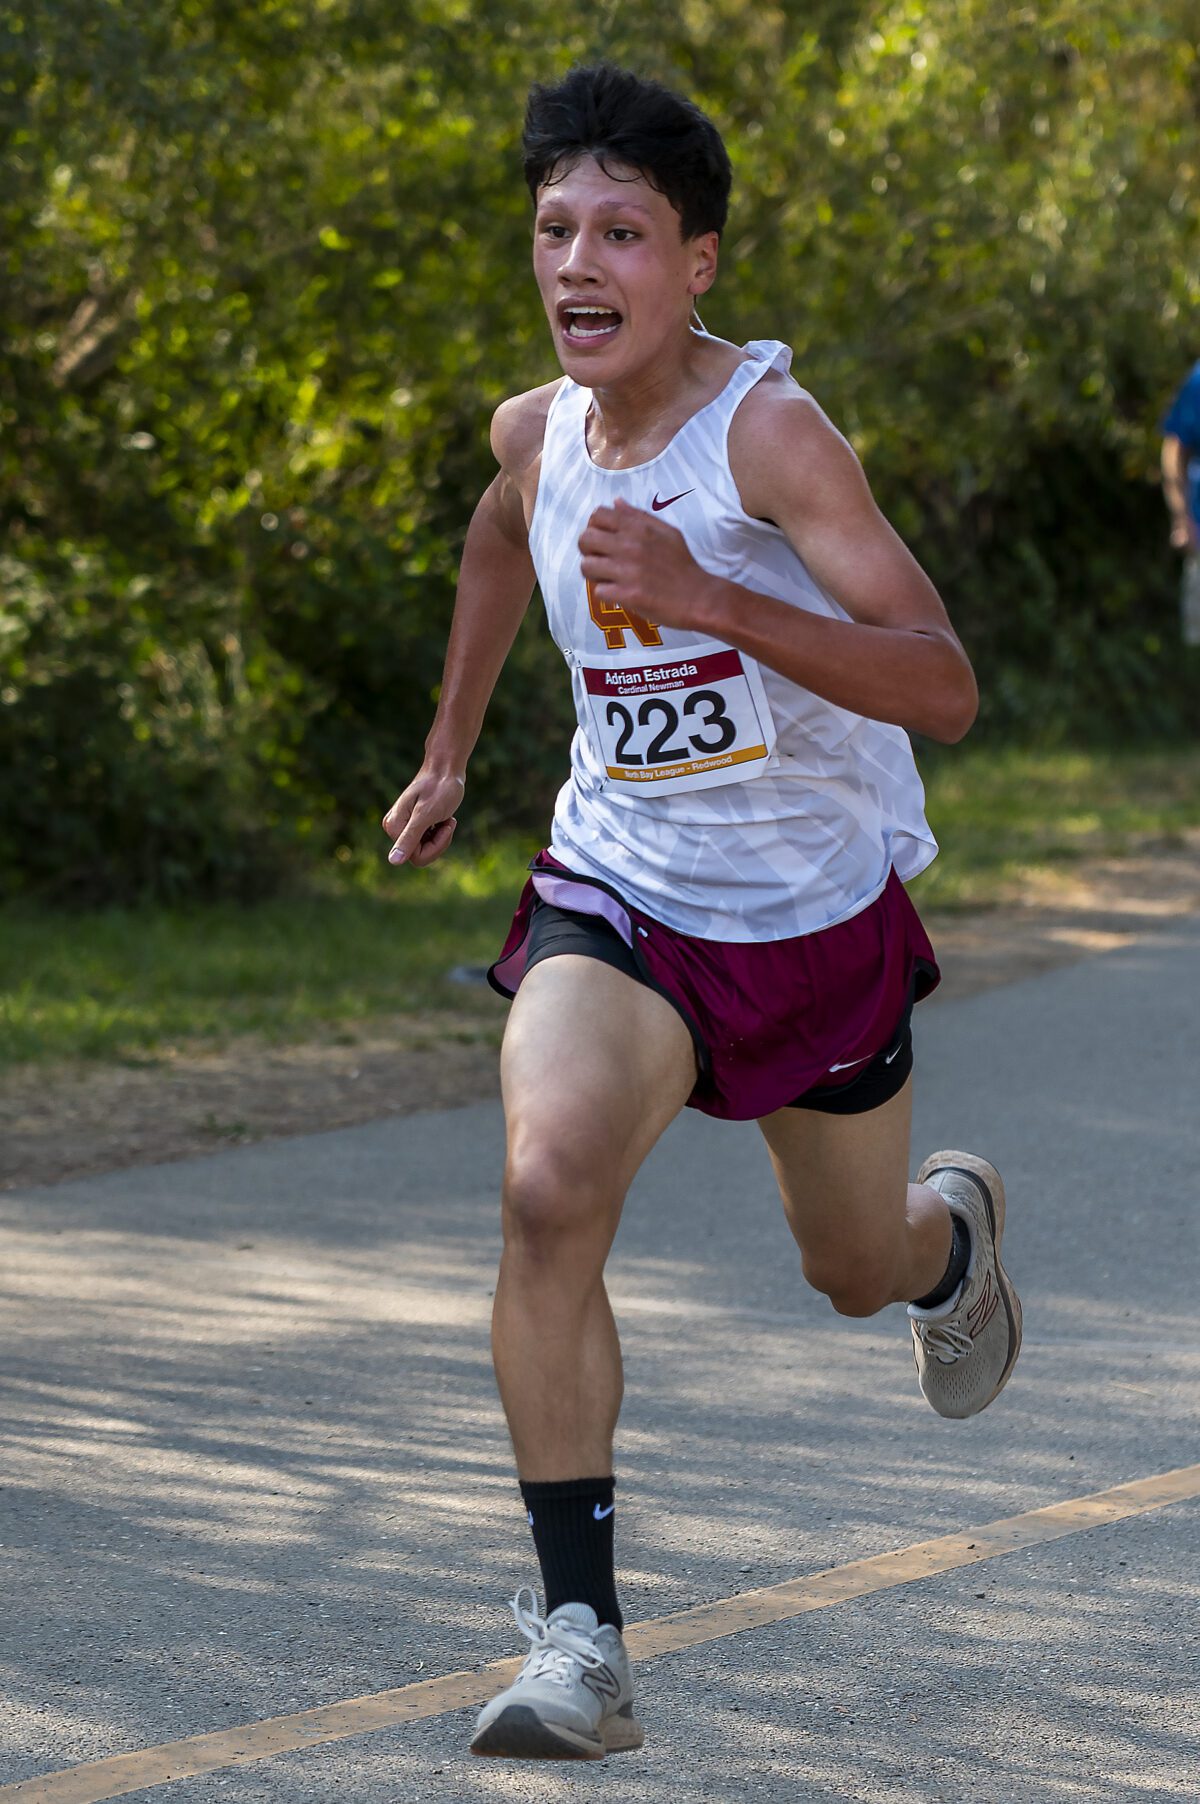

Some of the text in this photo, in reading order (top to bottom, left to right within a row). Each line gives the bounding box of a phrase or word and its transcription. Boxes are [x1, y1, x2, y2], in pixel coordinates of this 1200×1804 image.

[605, 663, 698, 685] Adrian Estrada
[617, 680, 685, 695] Cardinal Newman
[606, 690, 737, 766] 223
[640, 770, 654, 780] Bay
[655, 766, 685, 778] League
[692, 755, 733, 771] Redwood
